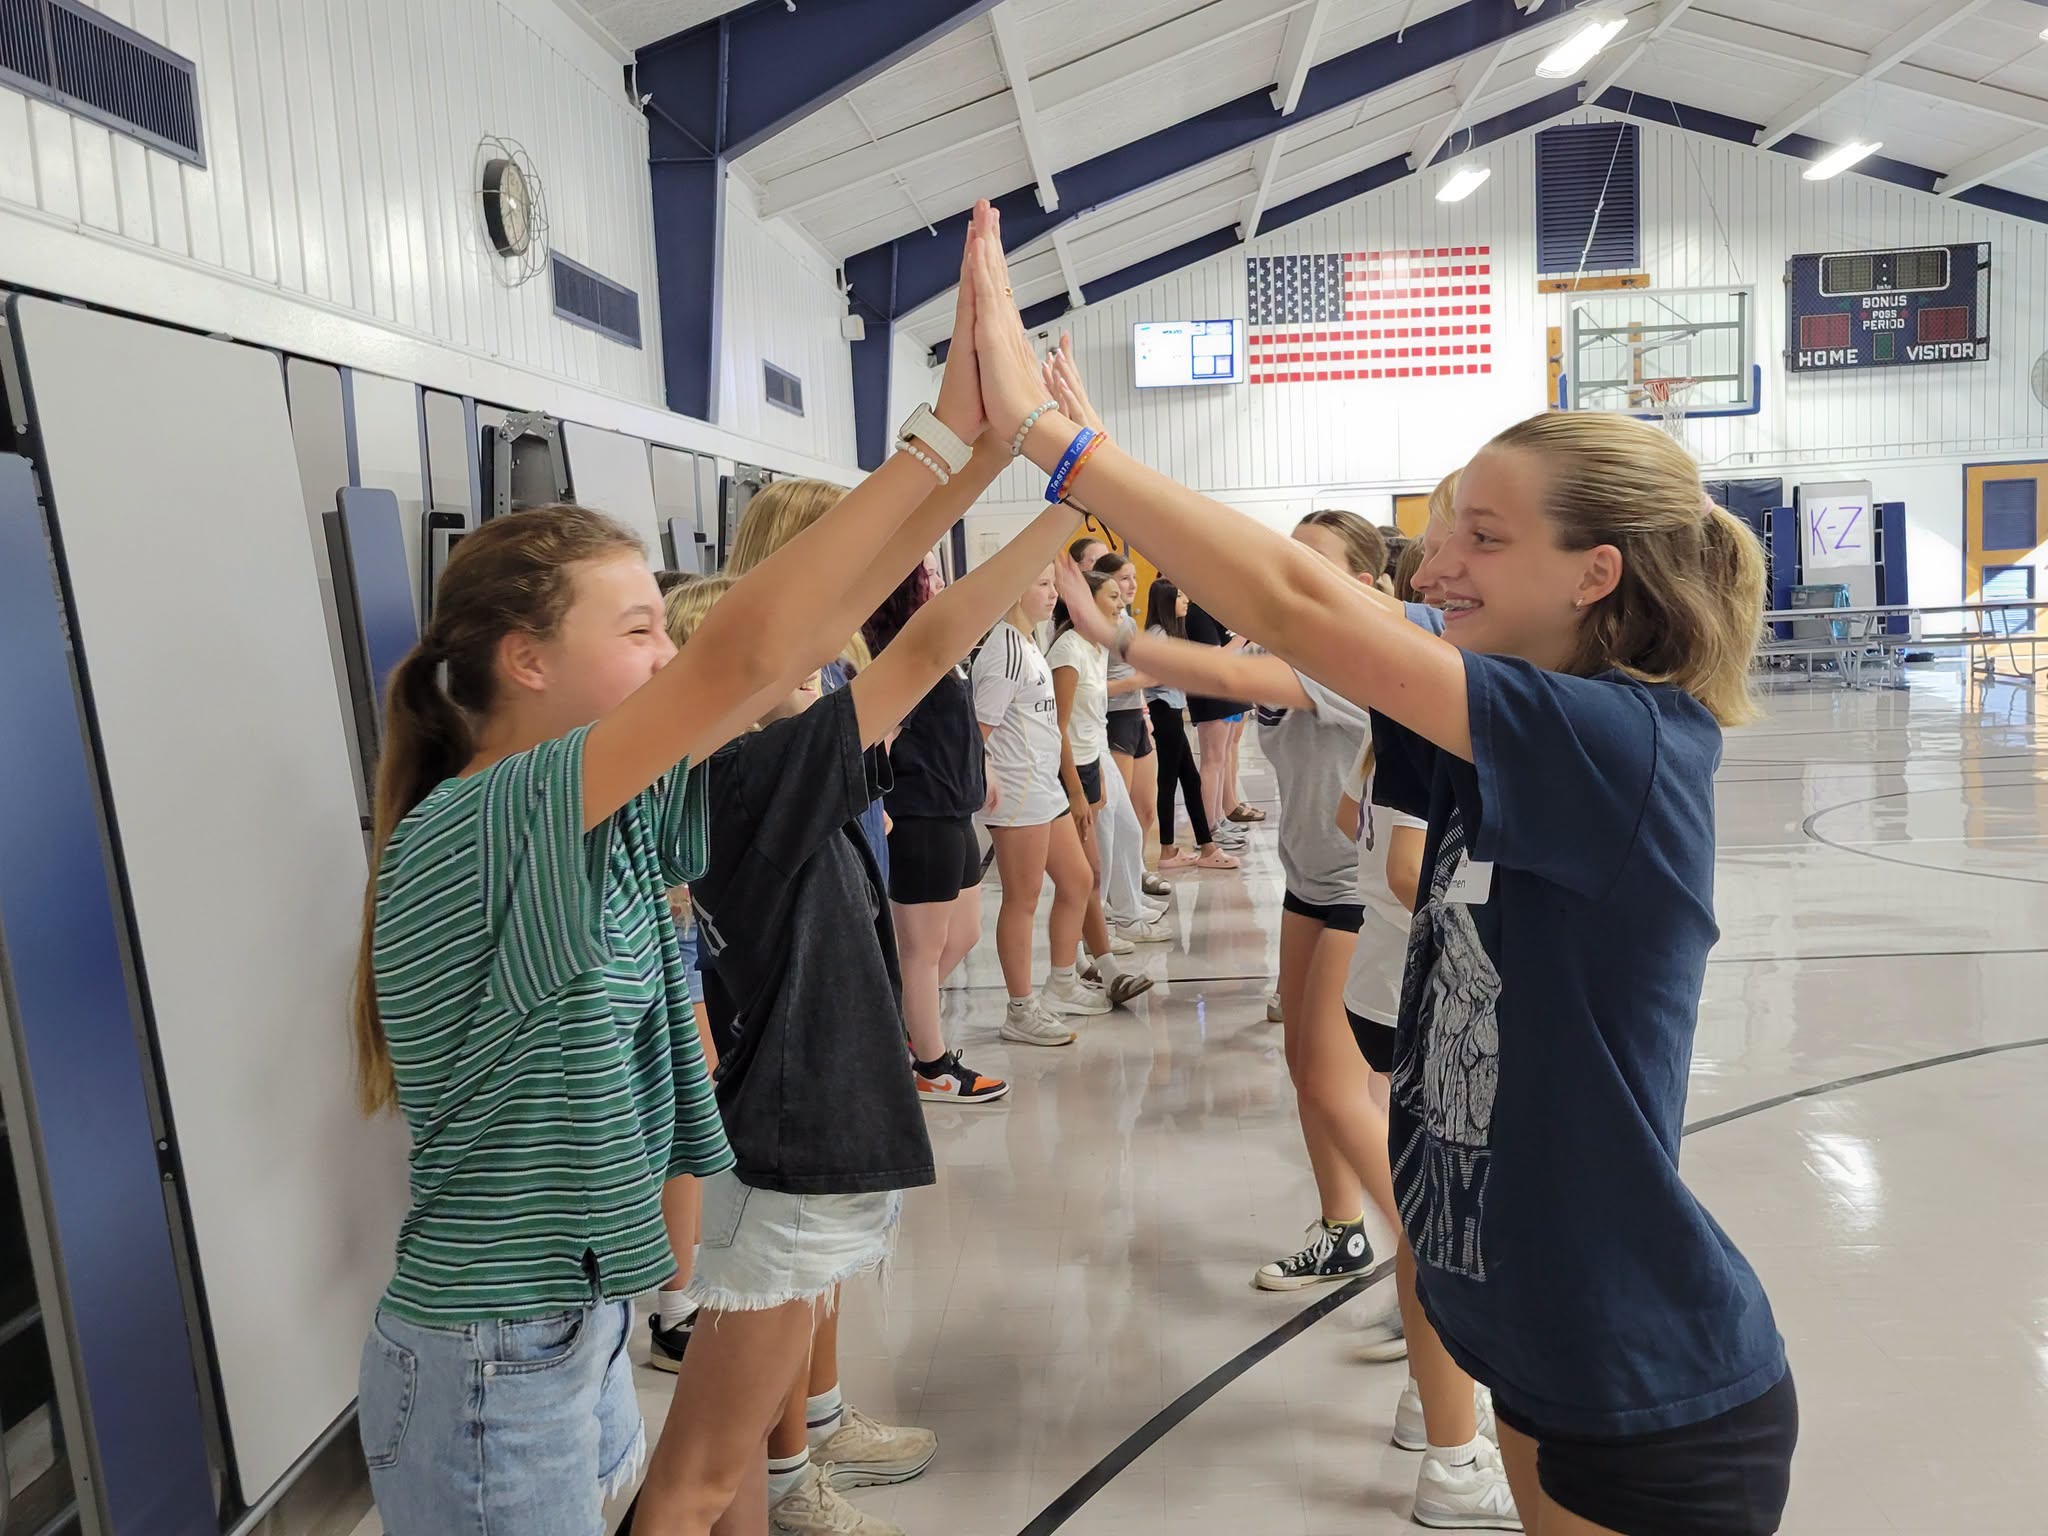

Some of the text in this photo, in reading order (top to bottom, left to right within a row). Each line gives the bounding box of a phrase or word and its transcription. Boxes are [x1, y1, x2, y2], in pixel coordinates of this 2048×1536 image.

[1862, 295, 1907, 309] BONUS
[1872, 309, 1897, 319] POSS
[1862, 319, 1905, 331] PERIOD
[1799, 349, 1859, 367] HOME
[1906, 342, 1975, 361] VISITOR
[1050, 460, 1071, 493] Jesus
[1810, 506, 1863, 556] K-Z
